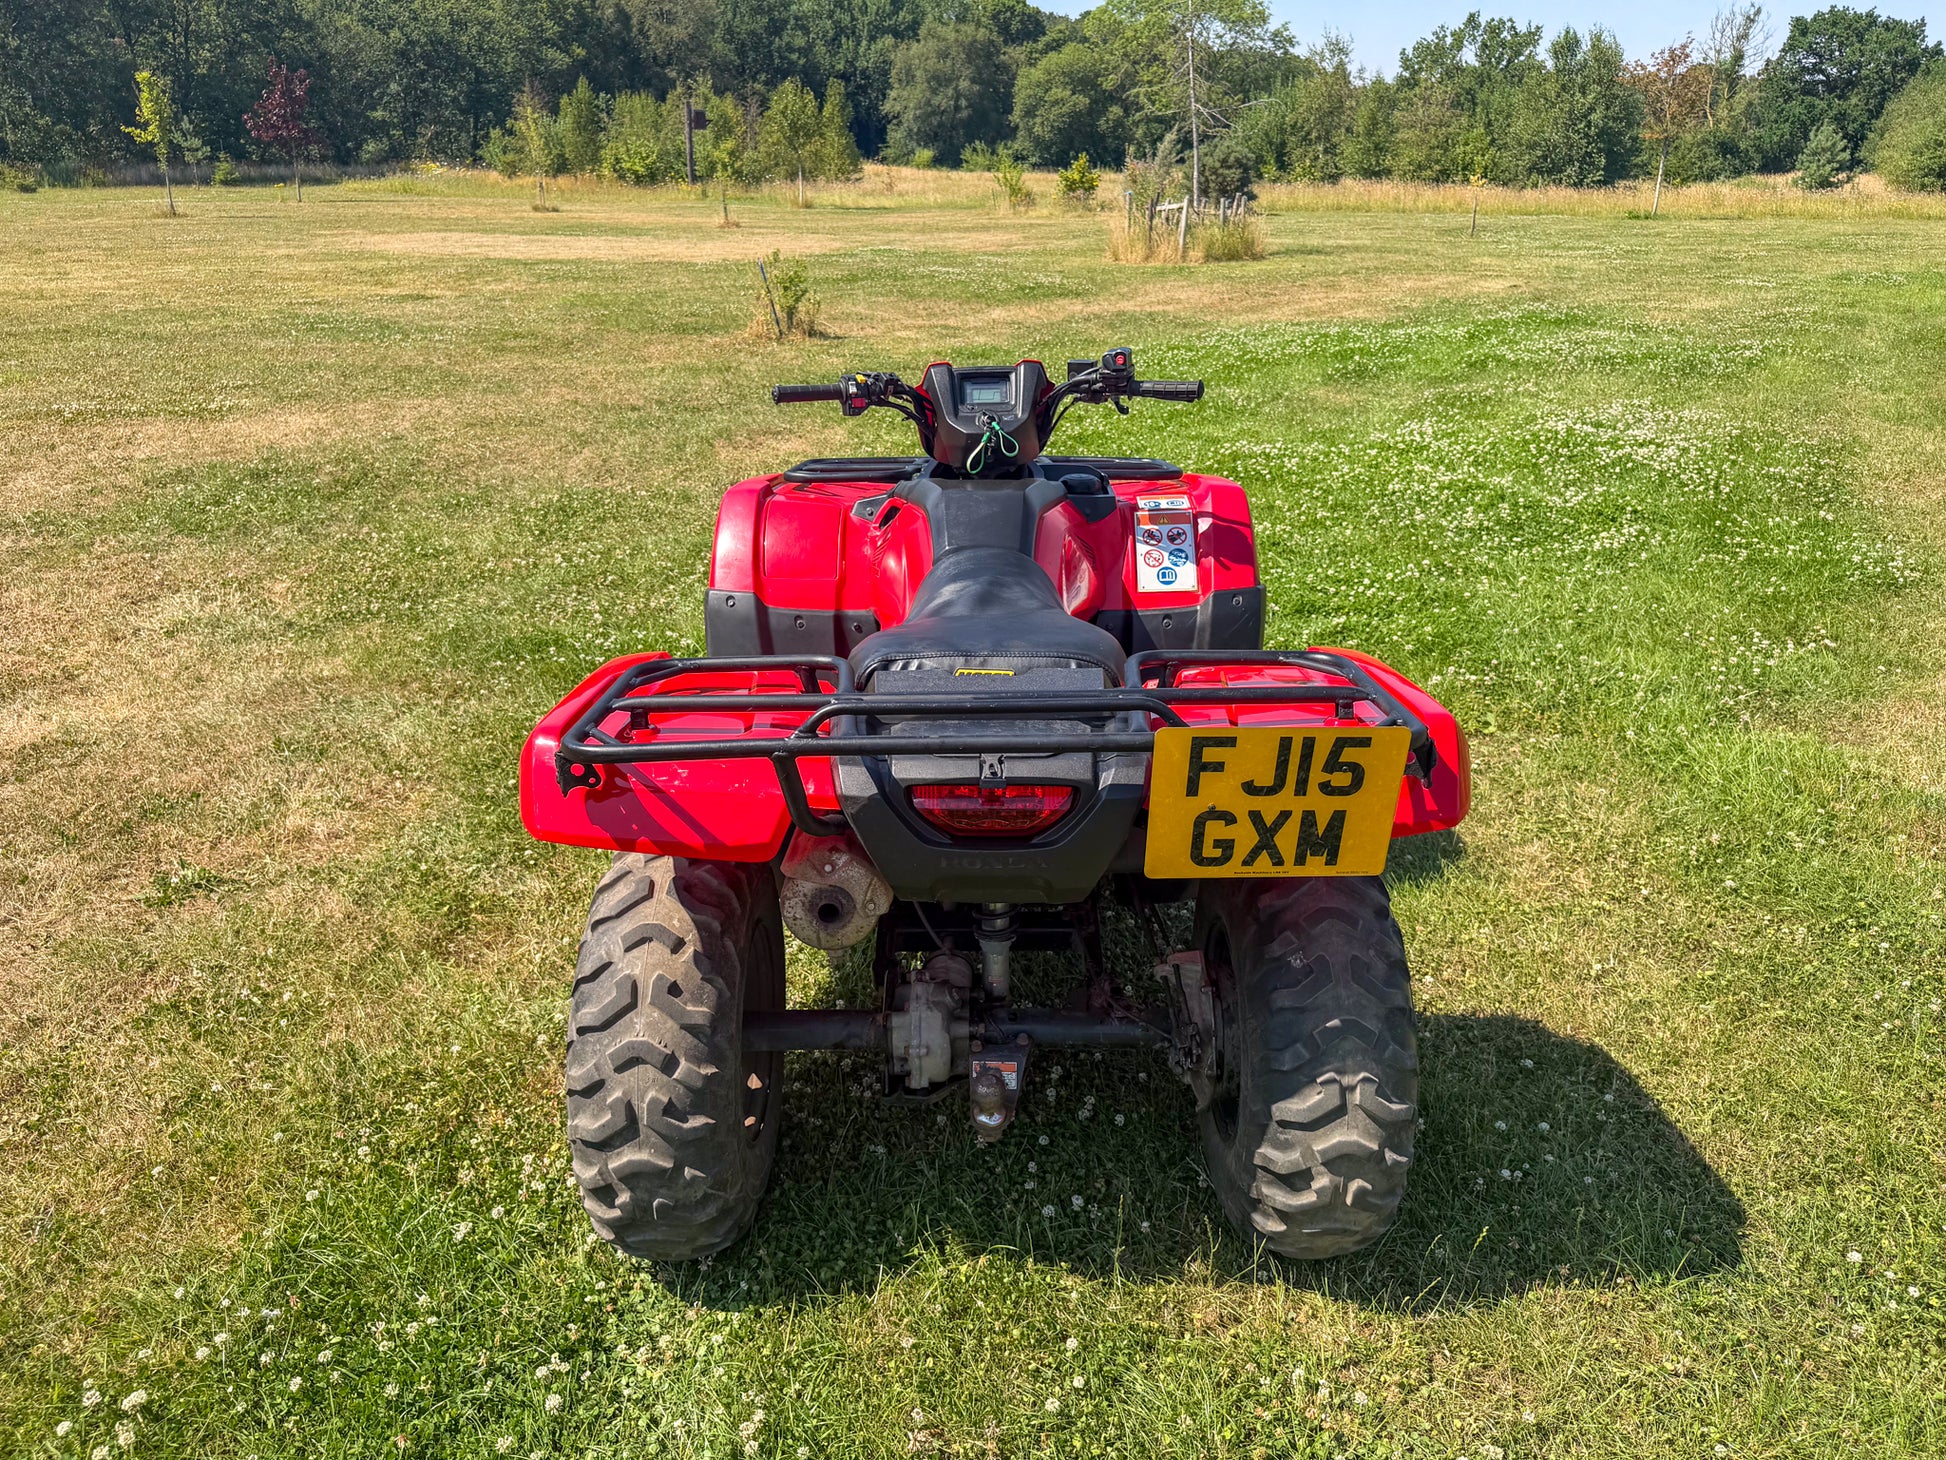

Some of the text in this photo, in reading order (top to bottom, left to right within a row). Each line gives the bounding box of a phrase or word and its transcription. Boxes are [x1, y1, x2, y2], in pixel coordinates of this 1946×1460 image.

[1186, 736, 1373, 797] FJ15
[941, 856, 1049, 868] HONDA
[1190, 809, 1347, 867] GXM
